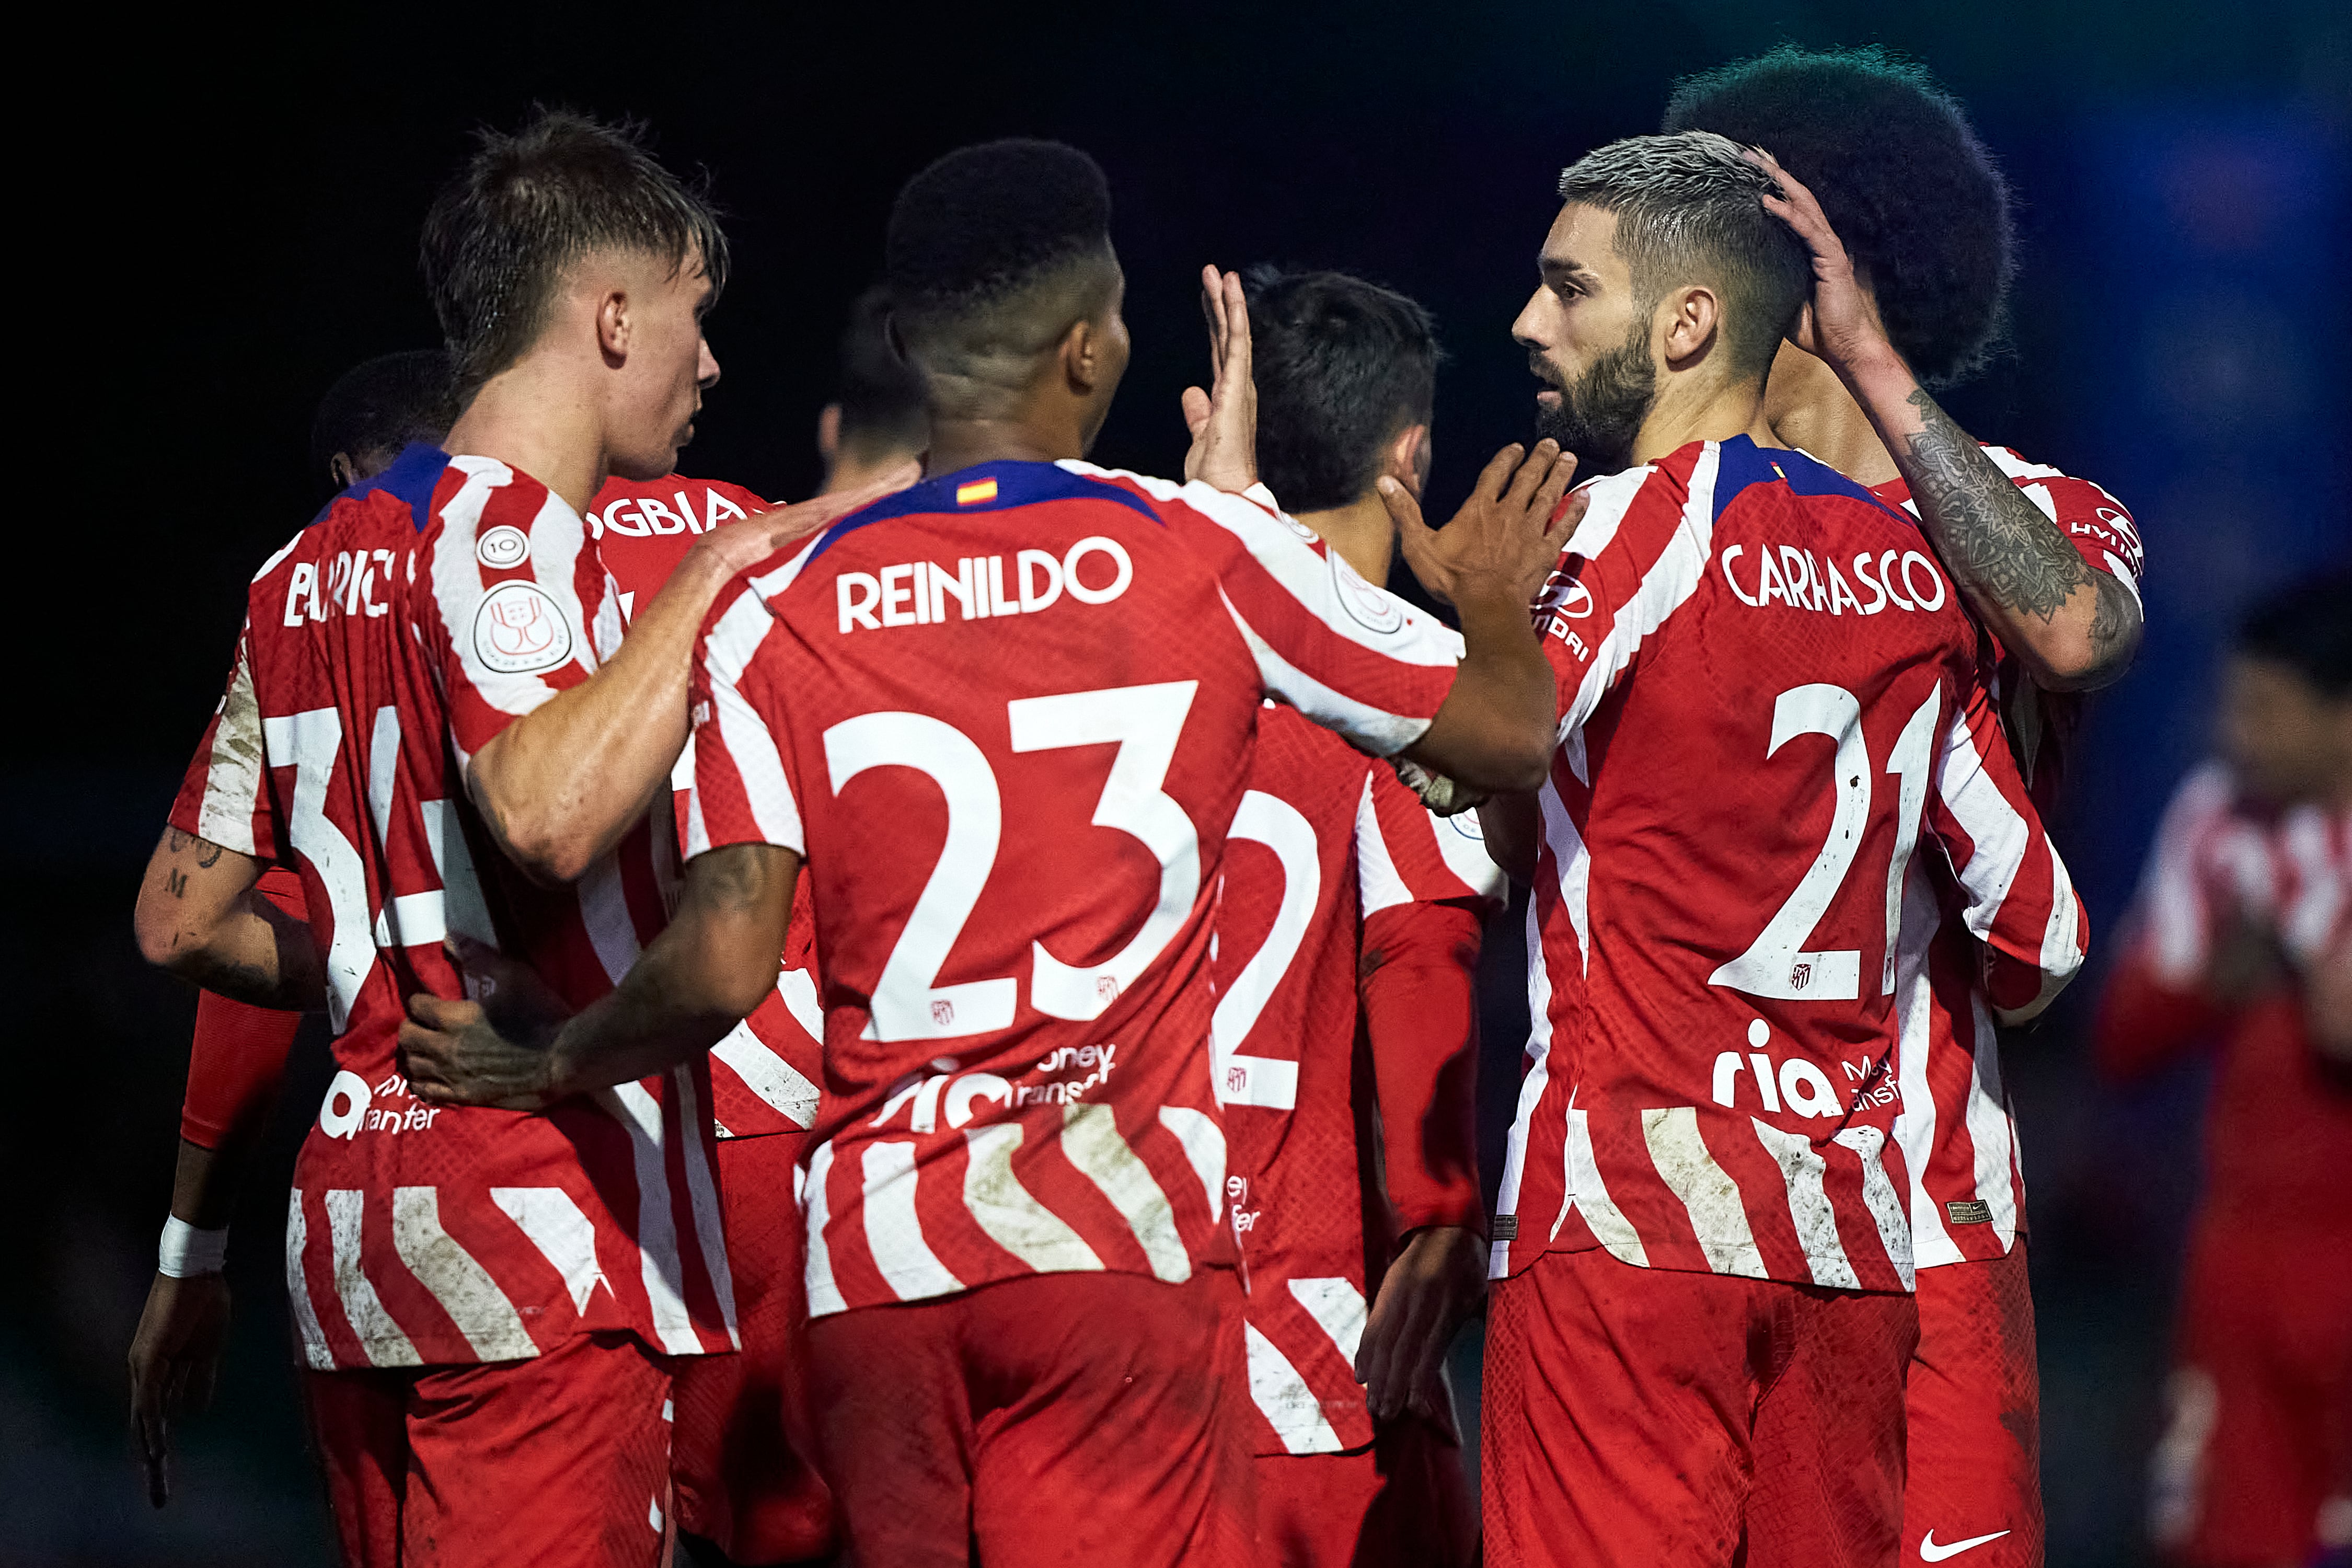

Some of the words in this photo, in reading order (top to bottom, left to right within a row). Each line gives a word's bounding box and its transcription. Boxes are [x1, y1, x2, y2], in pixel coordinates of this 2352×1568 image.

[837, 536, 1134, 635] REINILDO
[1721, 544, 1945, 616] CARRASCO
[822, 679, 1203, 1044] 23
[1708, 677, 1941, 1000] 21
[1712, 1018, 1844, 1119] ria
